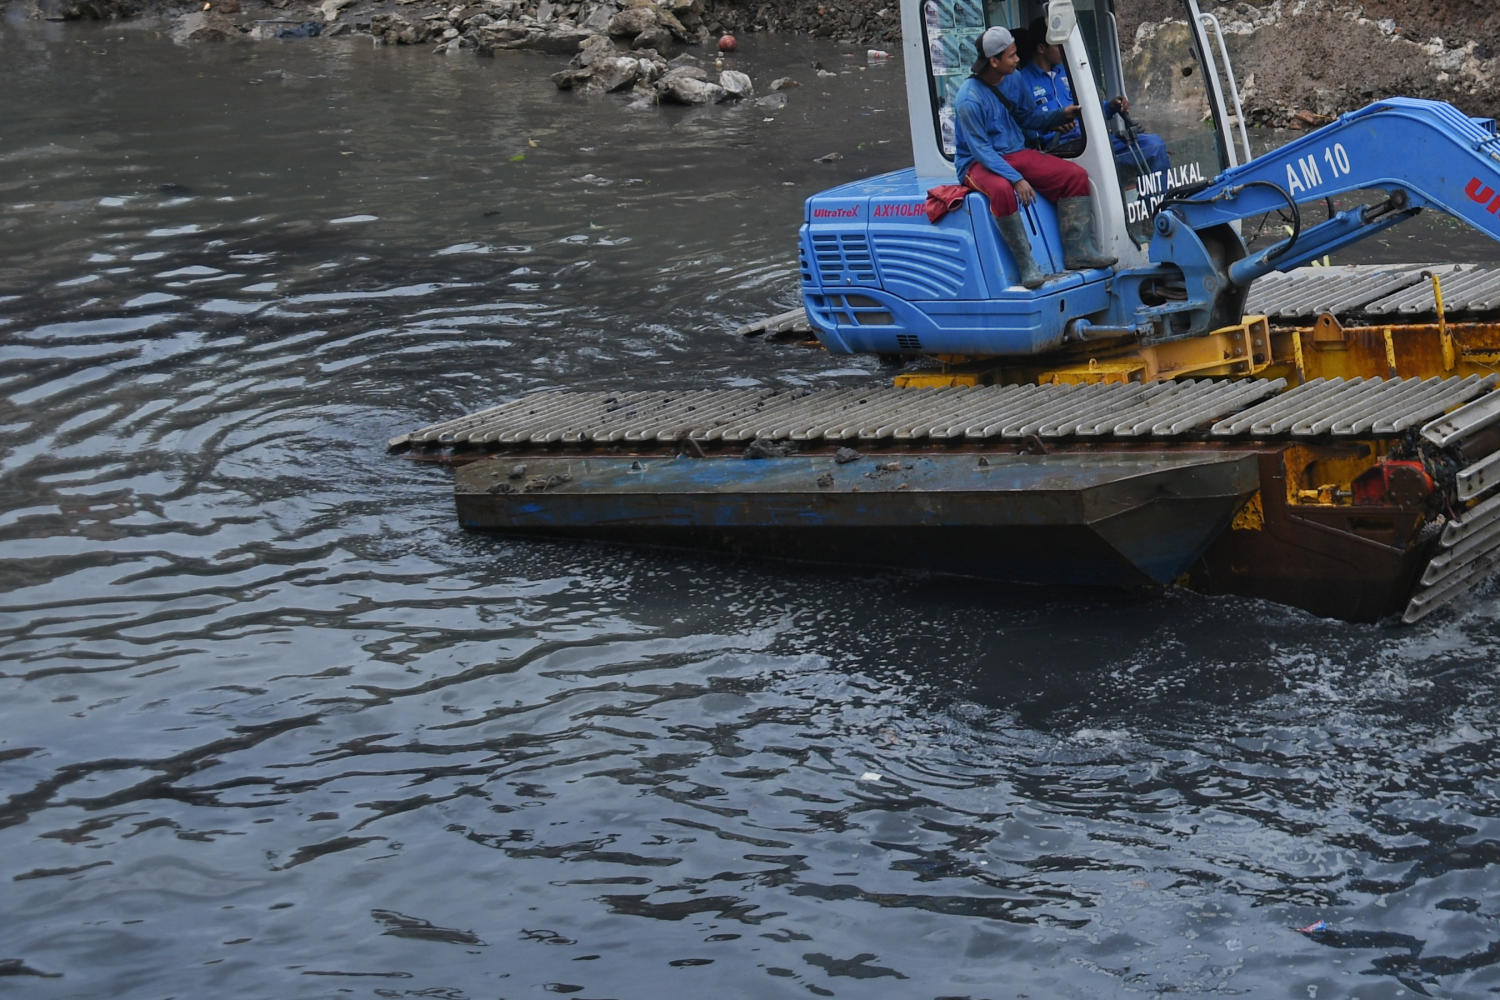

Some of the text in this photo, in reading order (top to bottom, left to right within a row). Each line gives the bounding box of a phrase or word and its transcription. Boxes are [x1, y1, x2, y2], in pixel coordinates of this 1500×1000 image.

[1136, 161, 1206, 197] UNIT ALKAL
[1286, 143, 1350, 196] AM 10
[813, 204, 861, 219] UltraTreX
[1127, 199, 1150, 224] DTA
